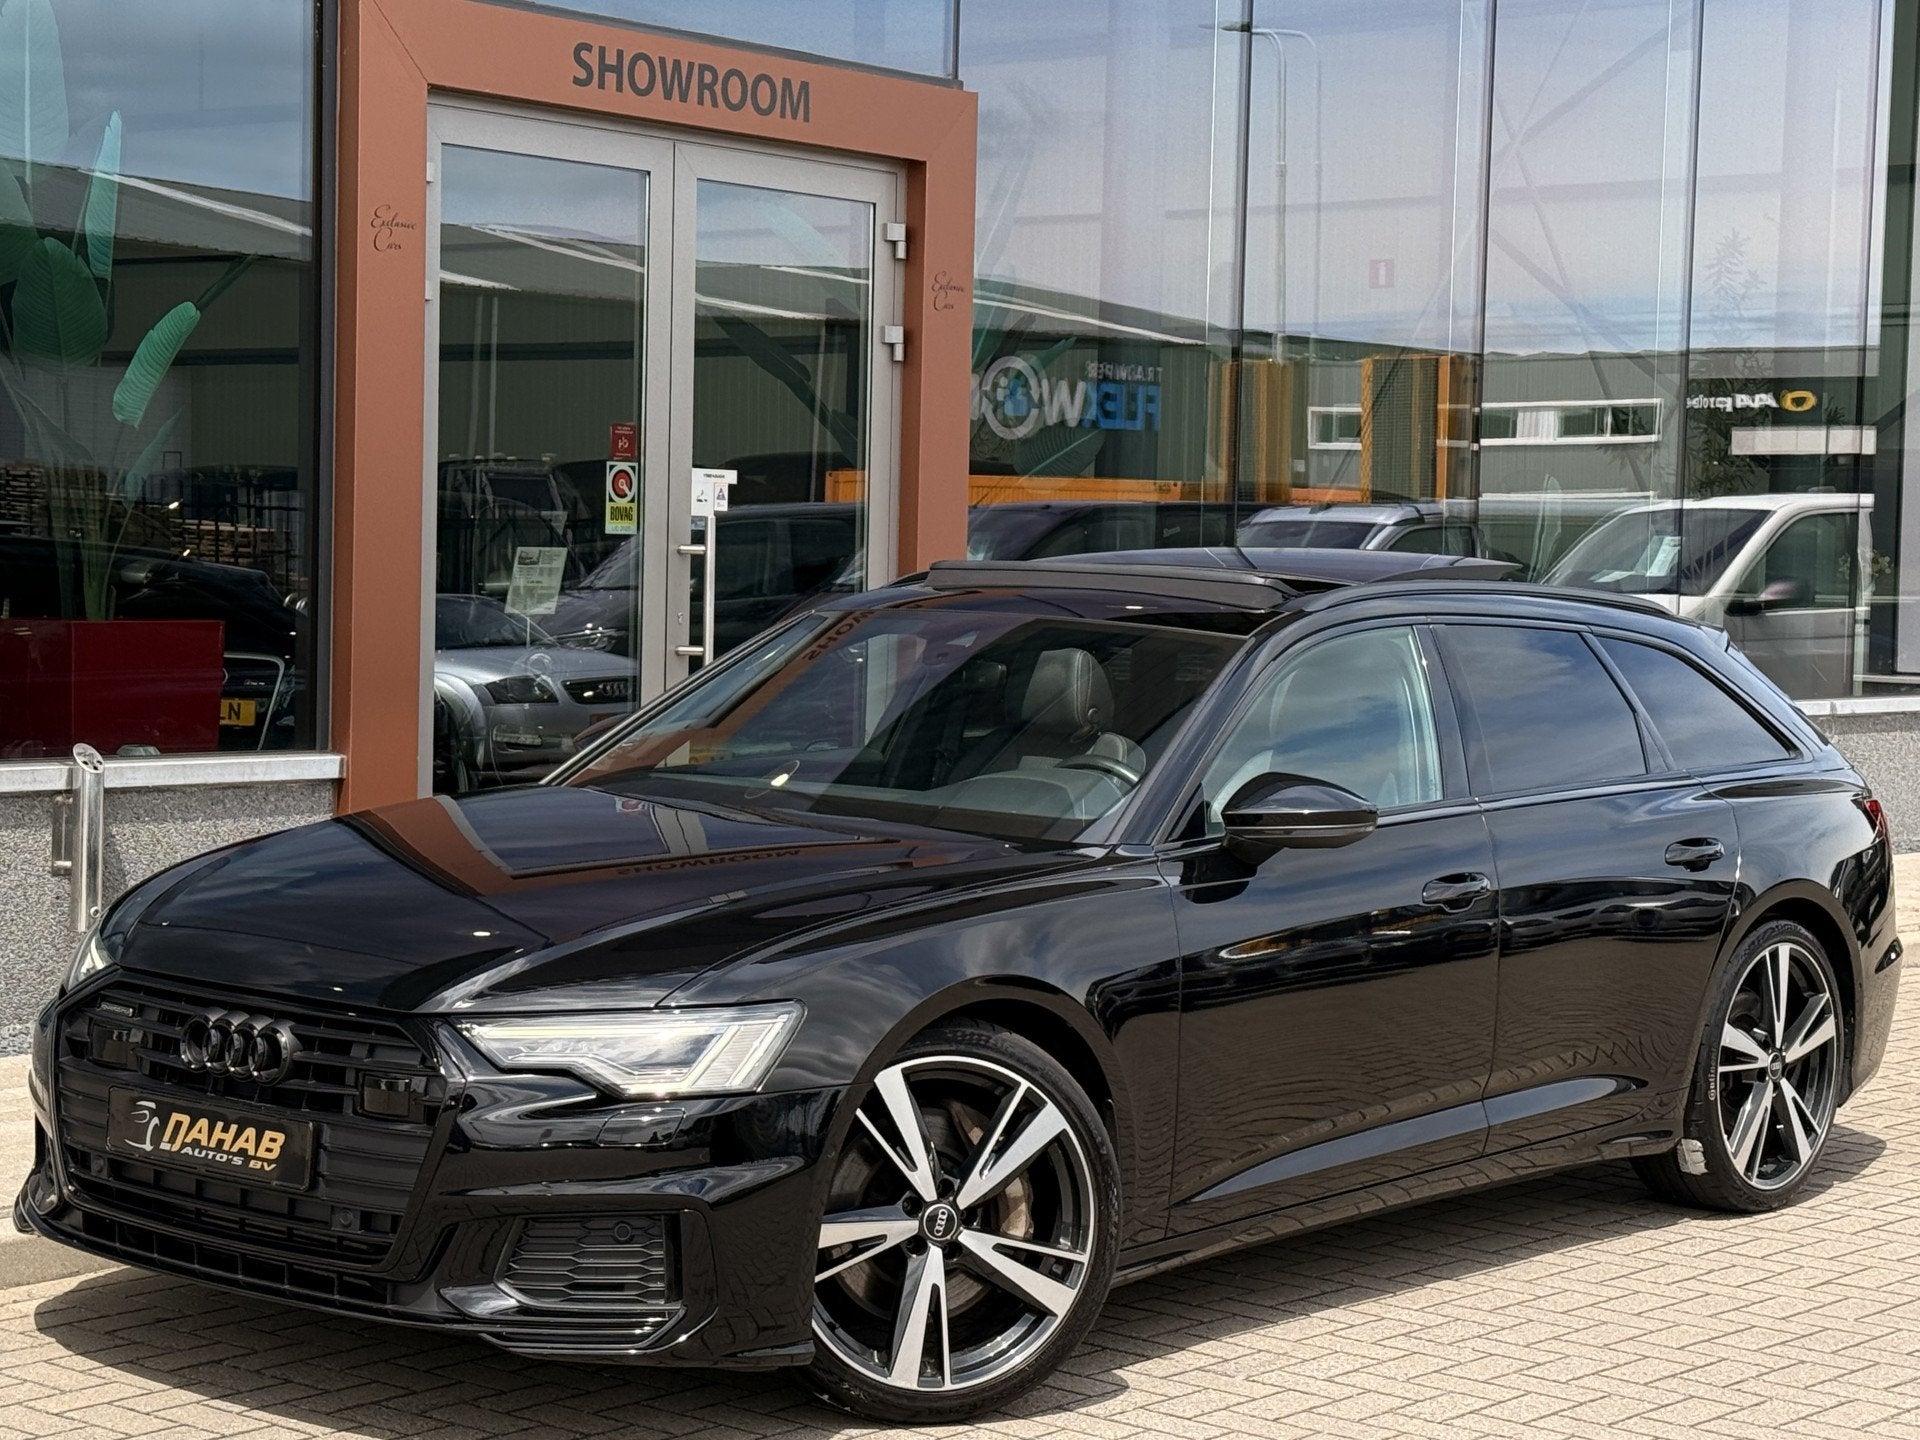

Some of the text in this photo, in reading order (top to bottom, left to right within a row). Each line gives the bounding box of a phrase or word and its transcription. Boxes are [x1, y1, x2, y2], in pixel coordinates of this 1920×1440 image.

[572, 42, 810, 123] SHOWROOM
[610, 506, 633, 521] BOVAG
[161, 1112, 286, 1160] DAHAB
[180, 1146, 277, 1172] AUTO'S BV
